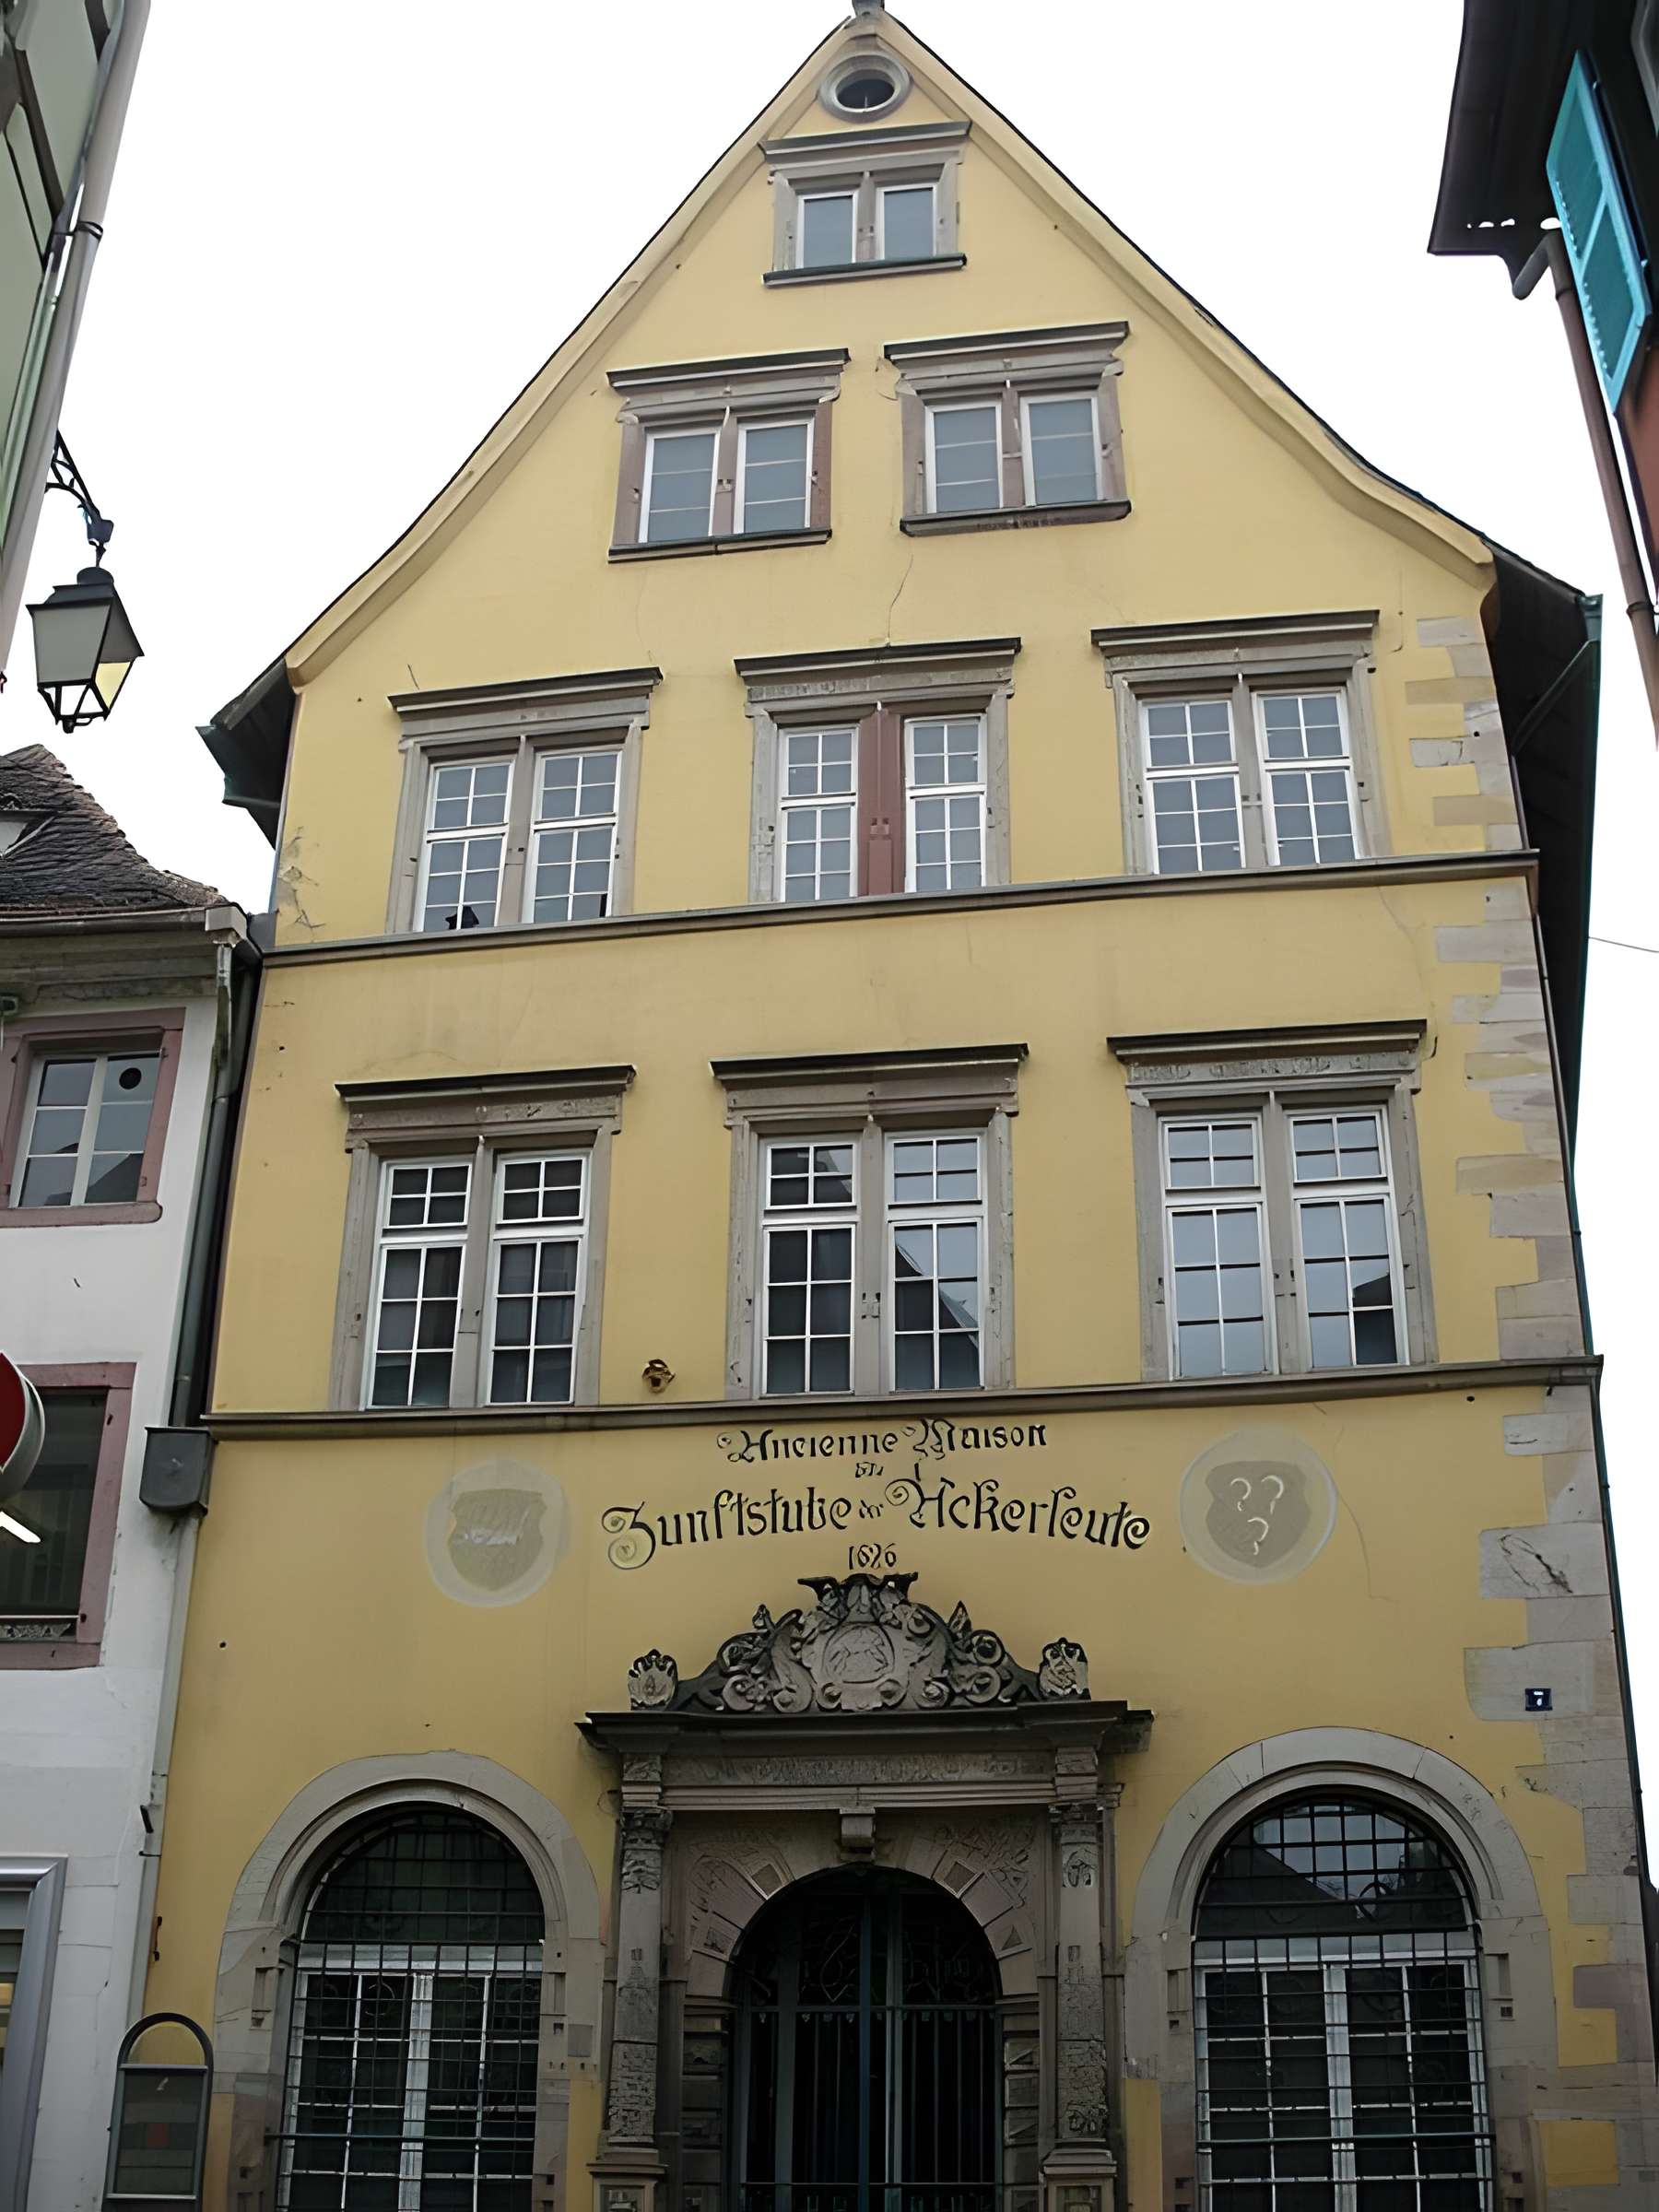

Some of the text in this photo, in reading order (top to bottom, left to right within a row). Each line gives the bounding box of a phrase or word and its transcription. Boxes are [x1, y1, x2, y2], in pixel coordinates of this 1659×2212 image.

[717, 1418, 1046, 1463] Ancienne Maison
[601, 1487, 852, 1571] Zunftstube
